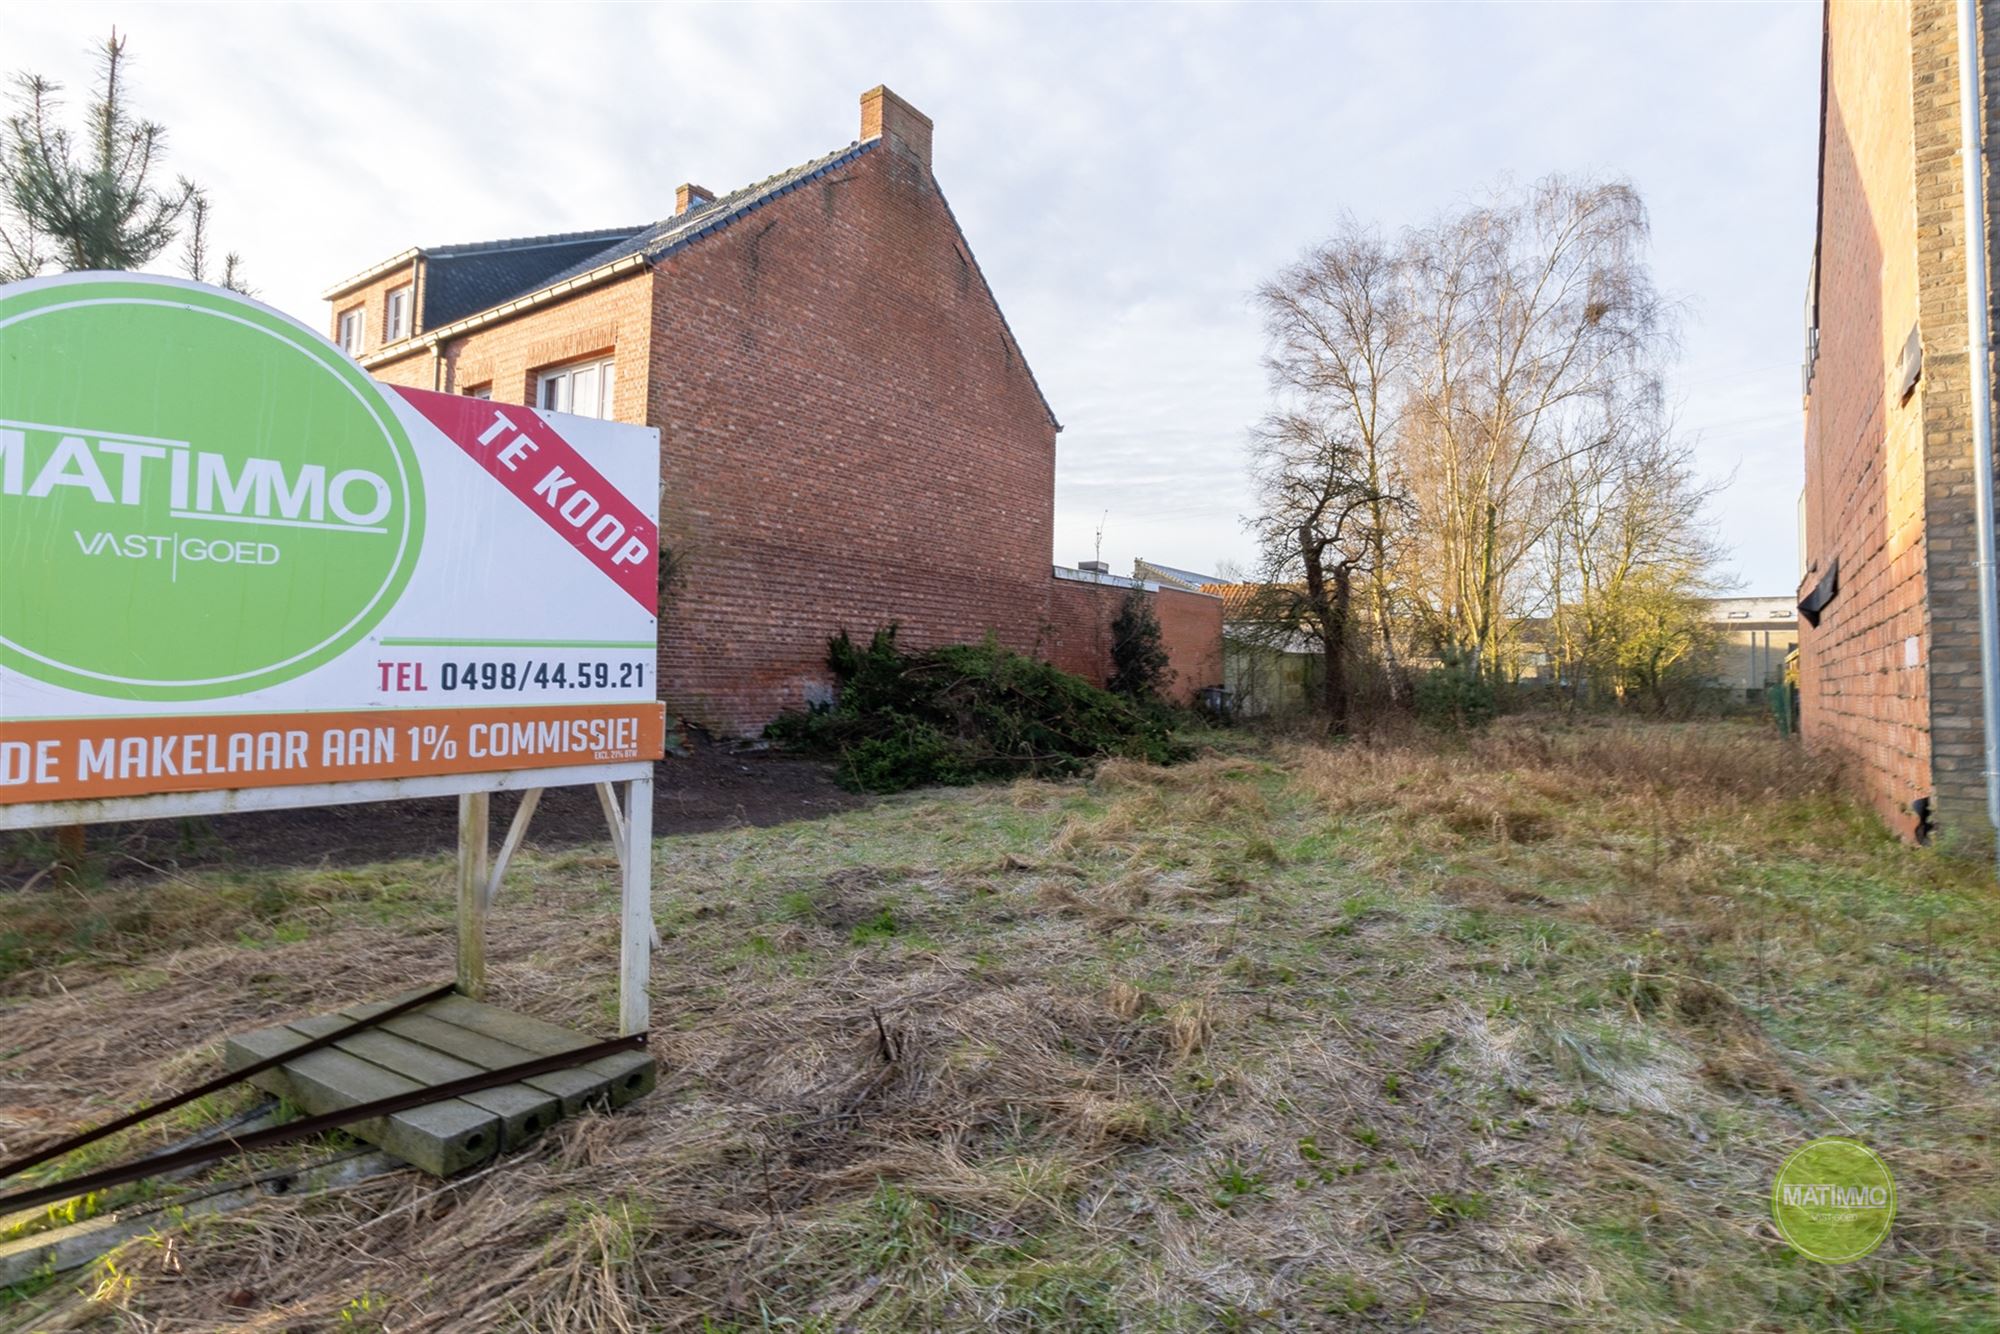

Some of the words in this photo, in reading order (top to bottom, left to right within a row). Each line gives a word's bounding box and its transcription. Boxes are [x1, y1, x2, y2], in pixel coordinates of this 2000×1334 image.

[477, 410, 540, 472] TE
[532, 465, 649, 566] KOOP
[378, 662, 428, 692] TEL
[441, 661, 644, 691] 0498/44.59.21
[0, 740, 60, 786] DE
[78, 731, 309, 781] MAKELAAR
[322, 727, 395, 766] AAN
[407, 725, 457, 761] 1%
[468, 718, 639, 758] COMMISSIE!
